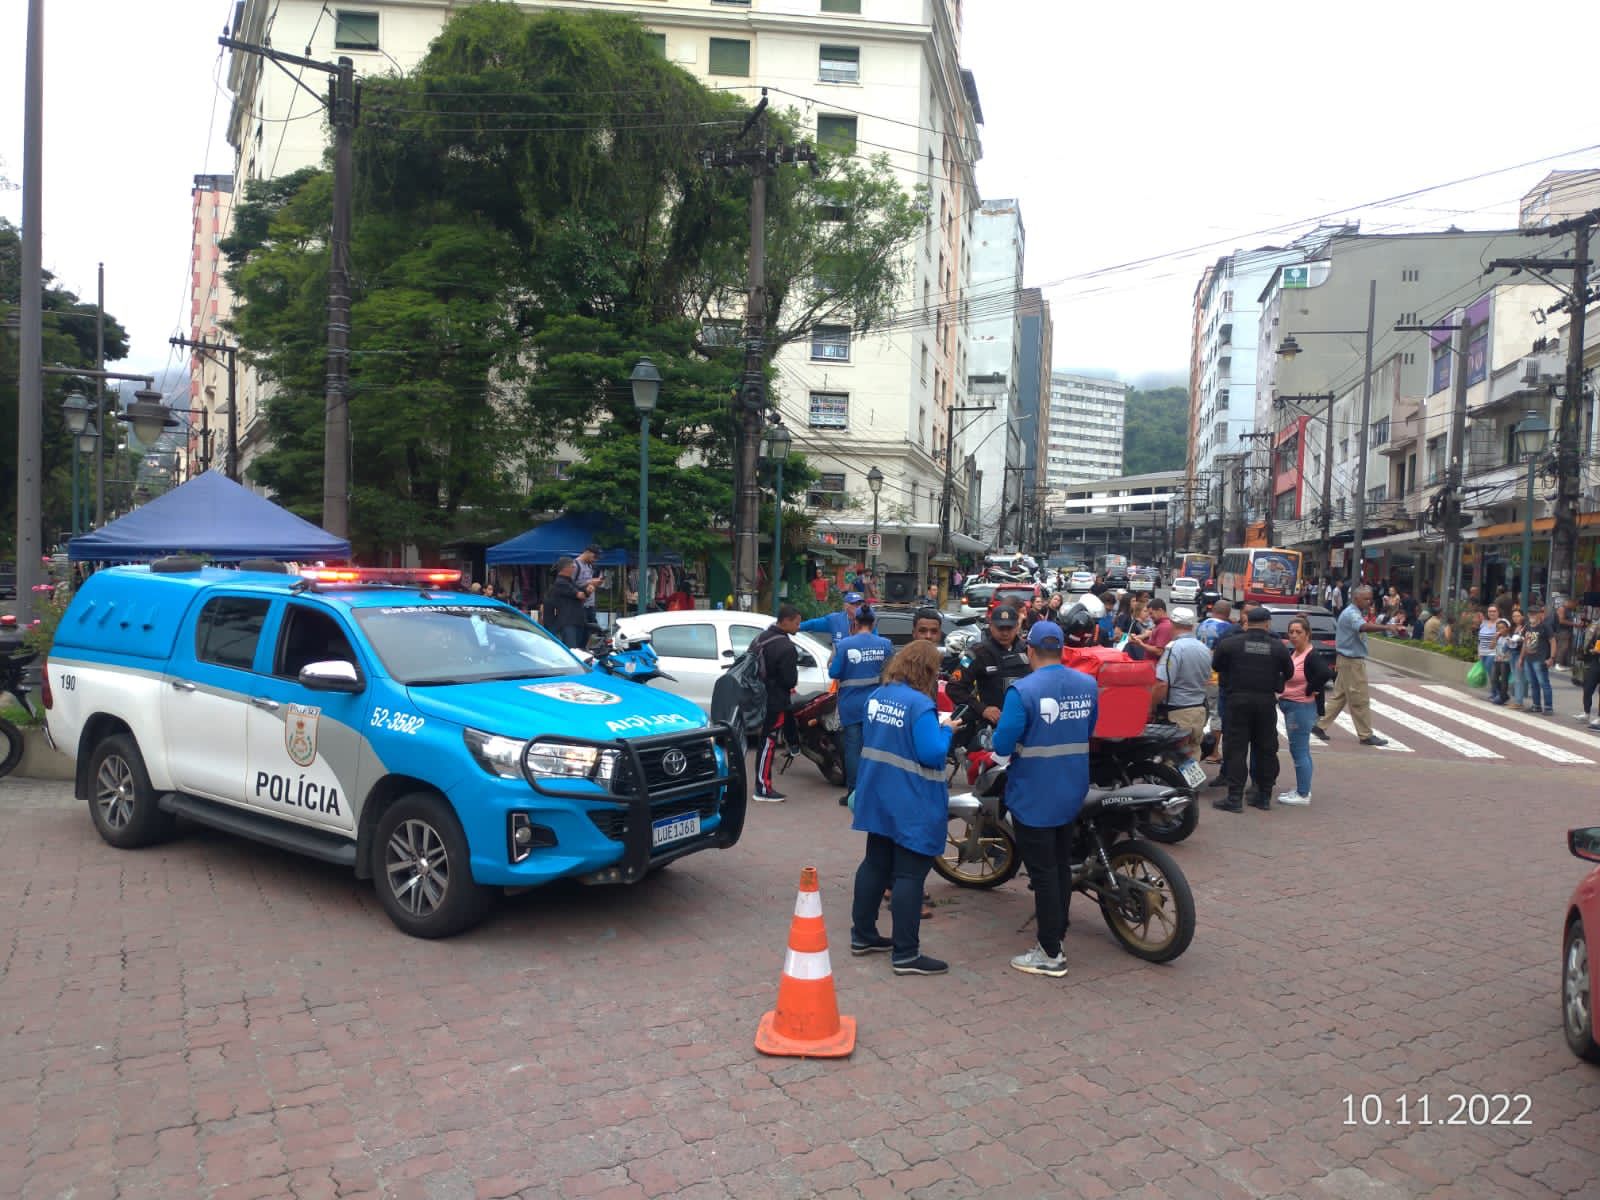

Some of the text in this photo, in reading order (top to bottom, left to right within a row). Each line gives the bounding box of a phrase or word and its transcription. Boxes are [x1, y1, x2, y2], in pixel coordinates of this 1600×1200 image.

[61, 674, 76, 691] 190
[878, 703, 905, 719] DETRAN
[1060, 700, 1091, 710] DETRAN
[370, 706, 425, 735] 52-3582
[875, 713, 904, 728] SEGURO
[1060, 709, 1091, 720] SEGURO
[256, 771, 341, 816] POLÍCIA
[1102, 796, 1133, 807] HONDA
